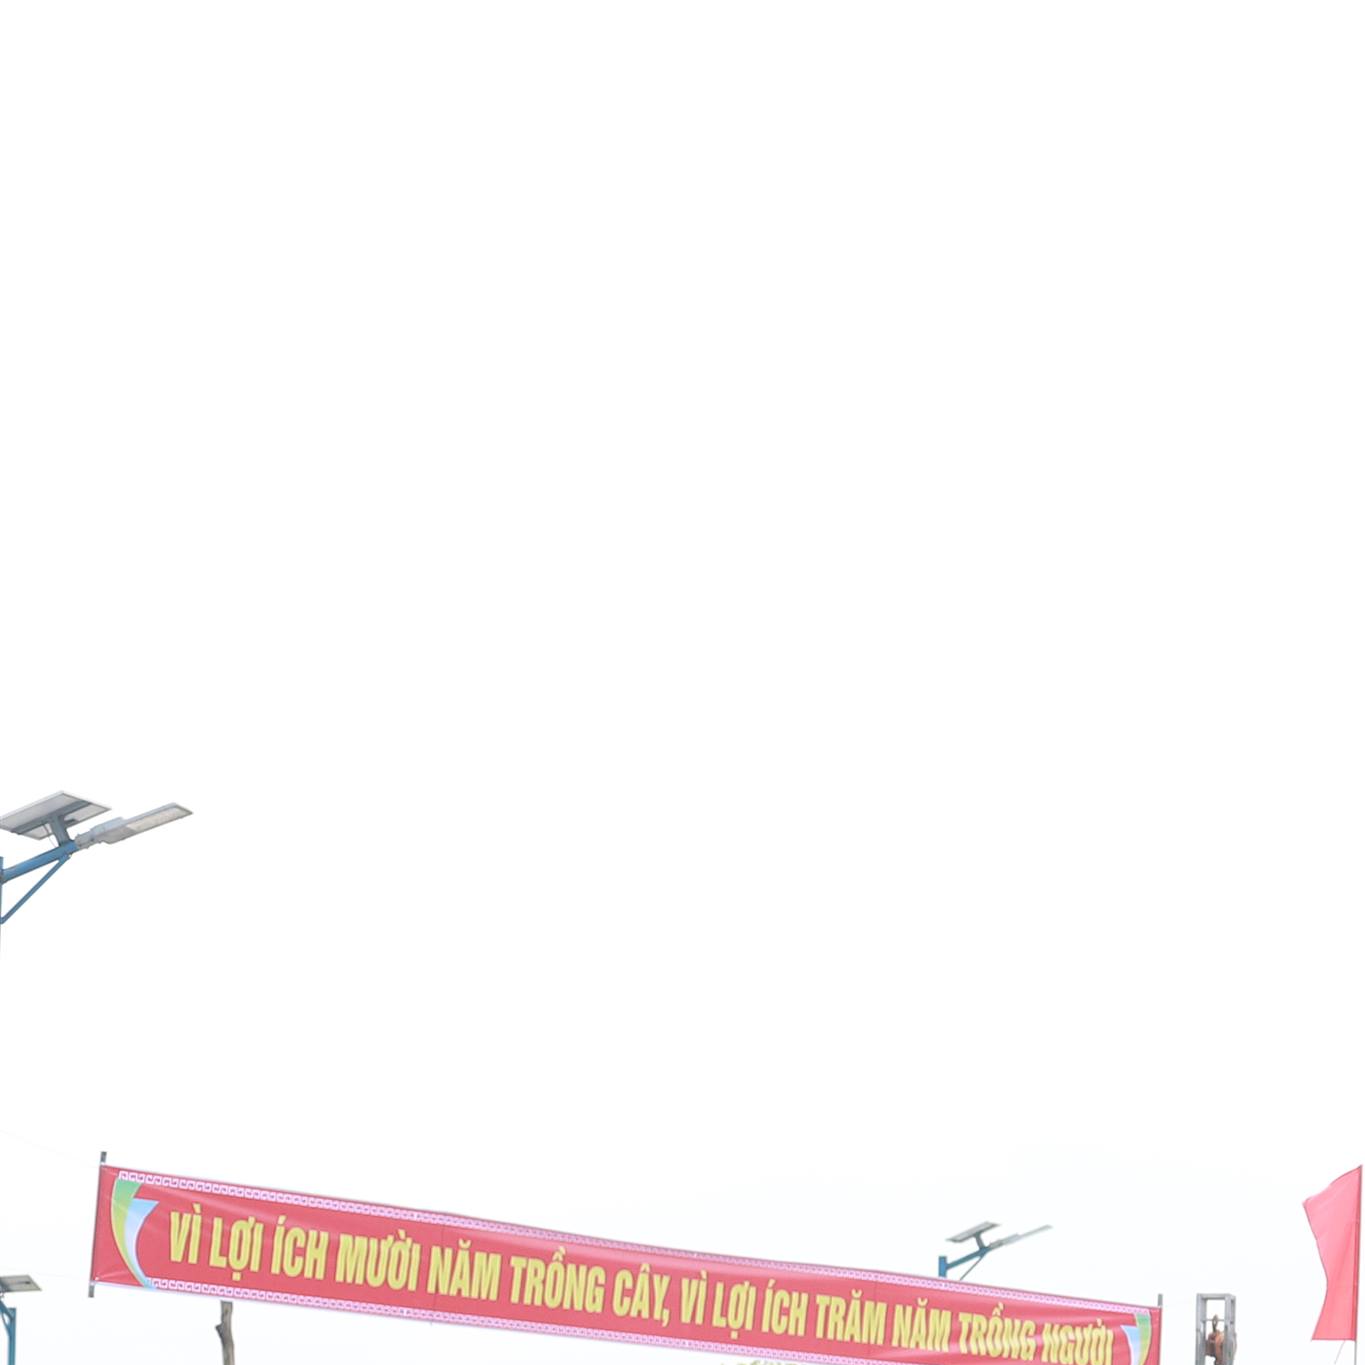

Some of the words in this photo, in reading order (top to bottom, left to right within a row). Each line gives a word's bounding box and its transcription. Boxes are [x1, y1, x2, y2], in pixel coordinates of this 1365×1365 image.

[169, 1203, 202, 1264] VÌ
[211, 1215, 264, 1281] LỢI
[271, 1215, 326, 1280] ÍCH
[335, 1229, 421, 1291] MƯỜI
[427, 1240, 504, 1301] NĂM
[509, 1246, 603, 1314] TRỒNG
[614, 1264, 672, 1328] CÂY,
[681, 1271, 709, 1325] VÌ
[712, 1279, 756, 1340] LỢI
[761, 1278, 804, 1336] ÍCH
[816, 1290, 886, 1345] TRĂM
[892, 1299, 950, 1352] NĂM
[958, 1303, 1036, 1361] TRỒNG
